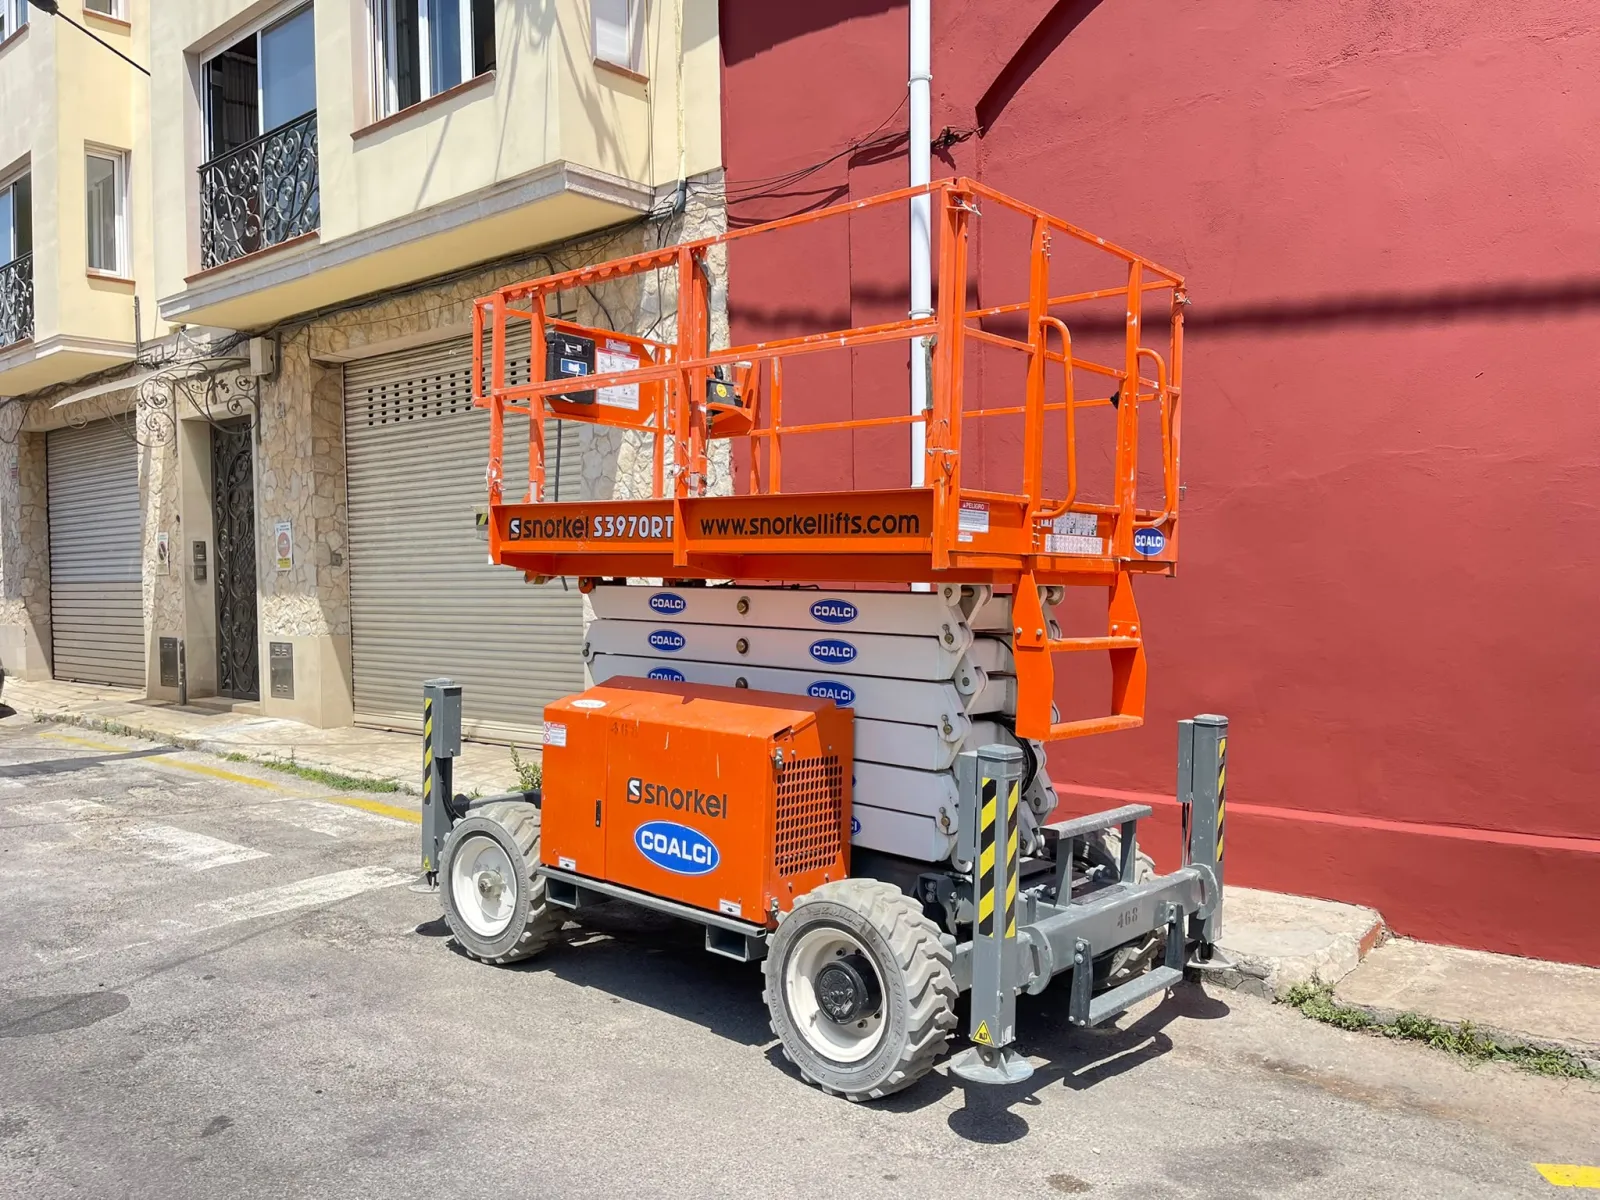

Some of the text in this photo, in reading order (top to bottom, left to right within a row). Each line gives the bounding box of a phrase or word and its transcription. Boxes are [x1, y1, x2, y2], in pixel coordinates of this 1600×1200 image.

[966, 502, 985, 510] PELIGRO
[523, 516, 589, 538] snorkel
[593, 514, 673, 538] S3970RT
[700, 512, 920, 535] www.snorkellifts.com
[1134, 534, 1163, 547] COALCI
[651, 598, 684, 609] COALCI
[813, 605, 855, 618] COALCI
[650, 635, 683, 646] COALCI
[812, 645, 854, 658] COALCI
[810, 687, 852, 701] COALCI
[644, 782, 728, 819] snorkel
[640, 830, 712, 866] COALCI
[1116, 906, 1138, 929] 468
